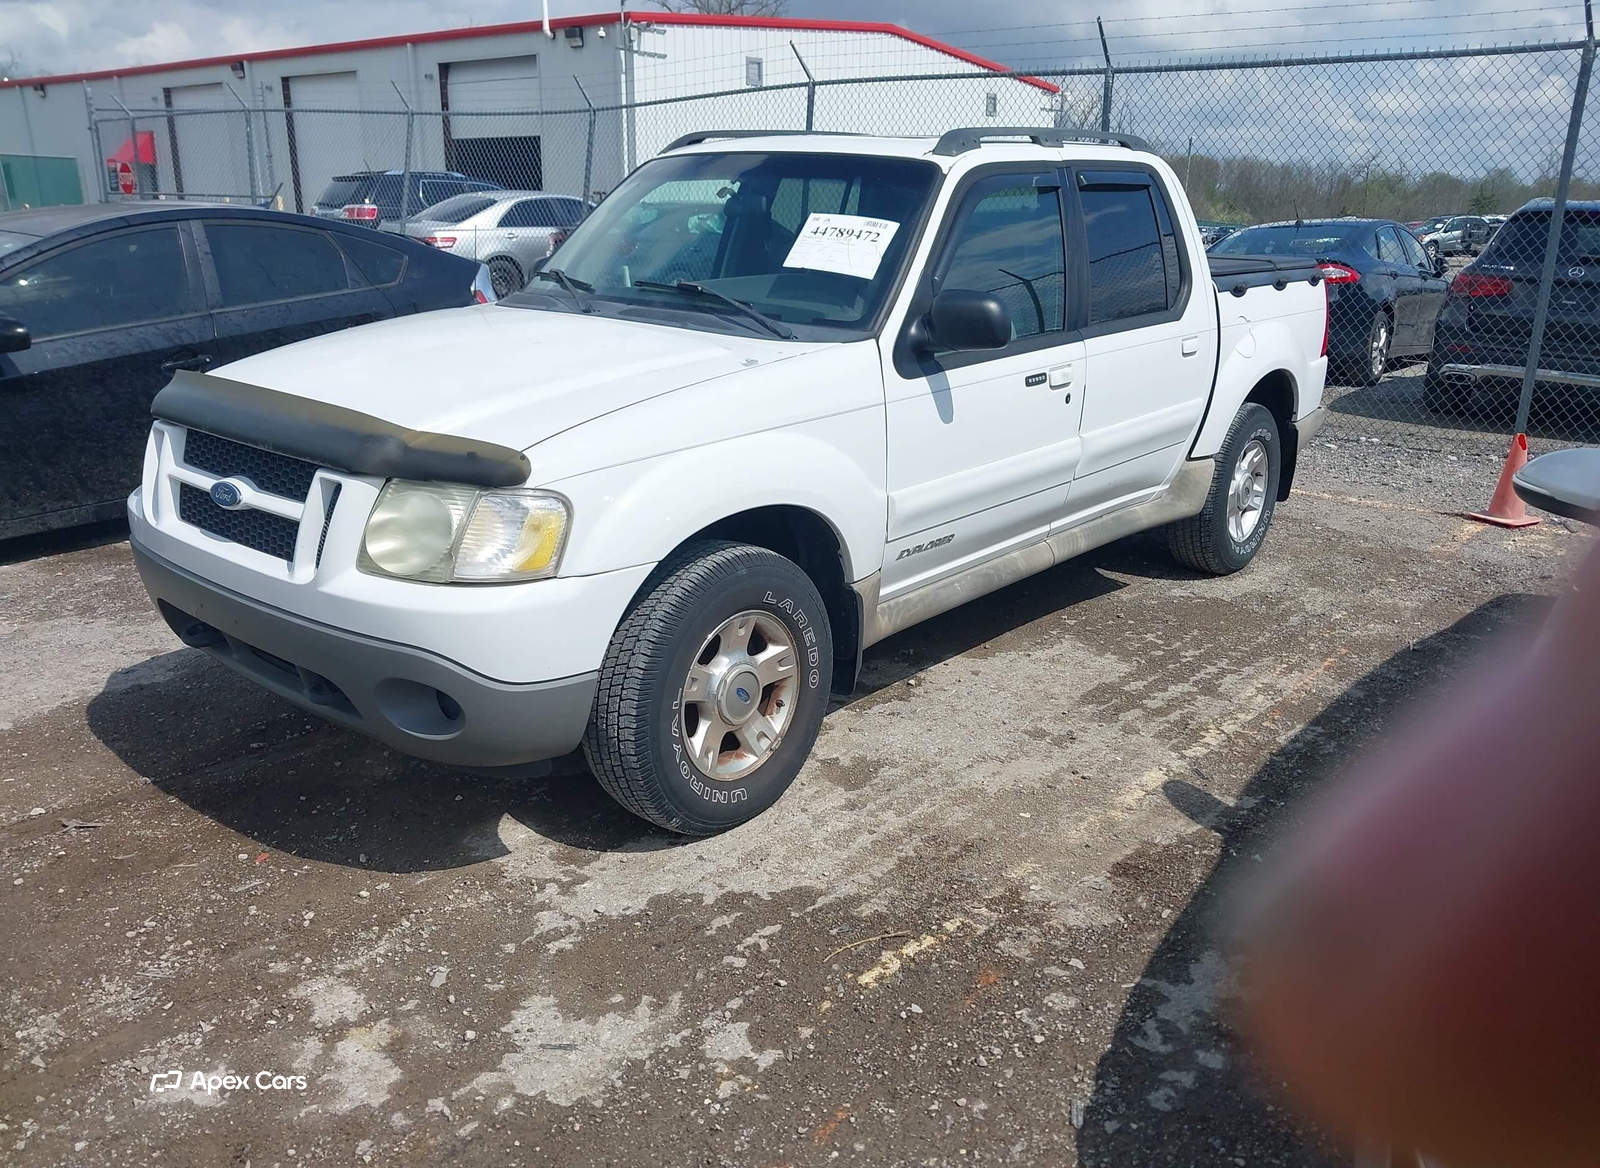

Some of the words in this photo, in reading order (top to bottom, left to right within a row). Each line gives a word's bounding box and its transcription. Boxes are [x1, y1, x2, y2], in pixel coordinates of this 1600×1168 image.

[810, 225, 881, 243] 44789472
[214, 485, 233, 502] Ford
[763, 590, 820, 689] LAREDO
[671, 687, 748, 804] UNIROYAL
